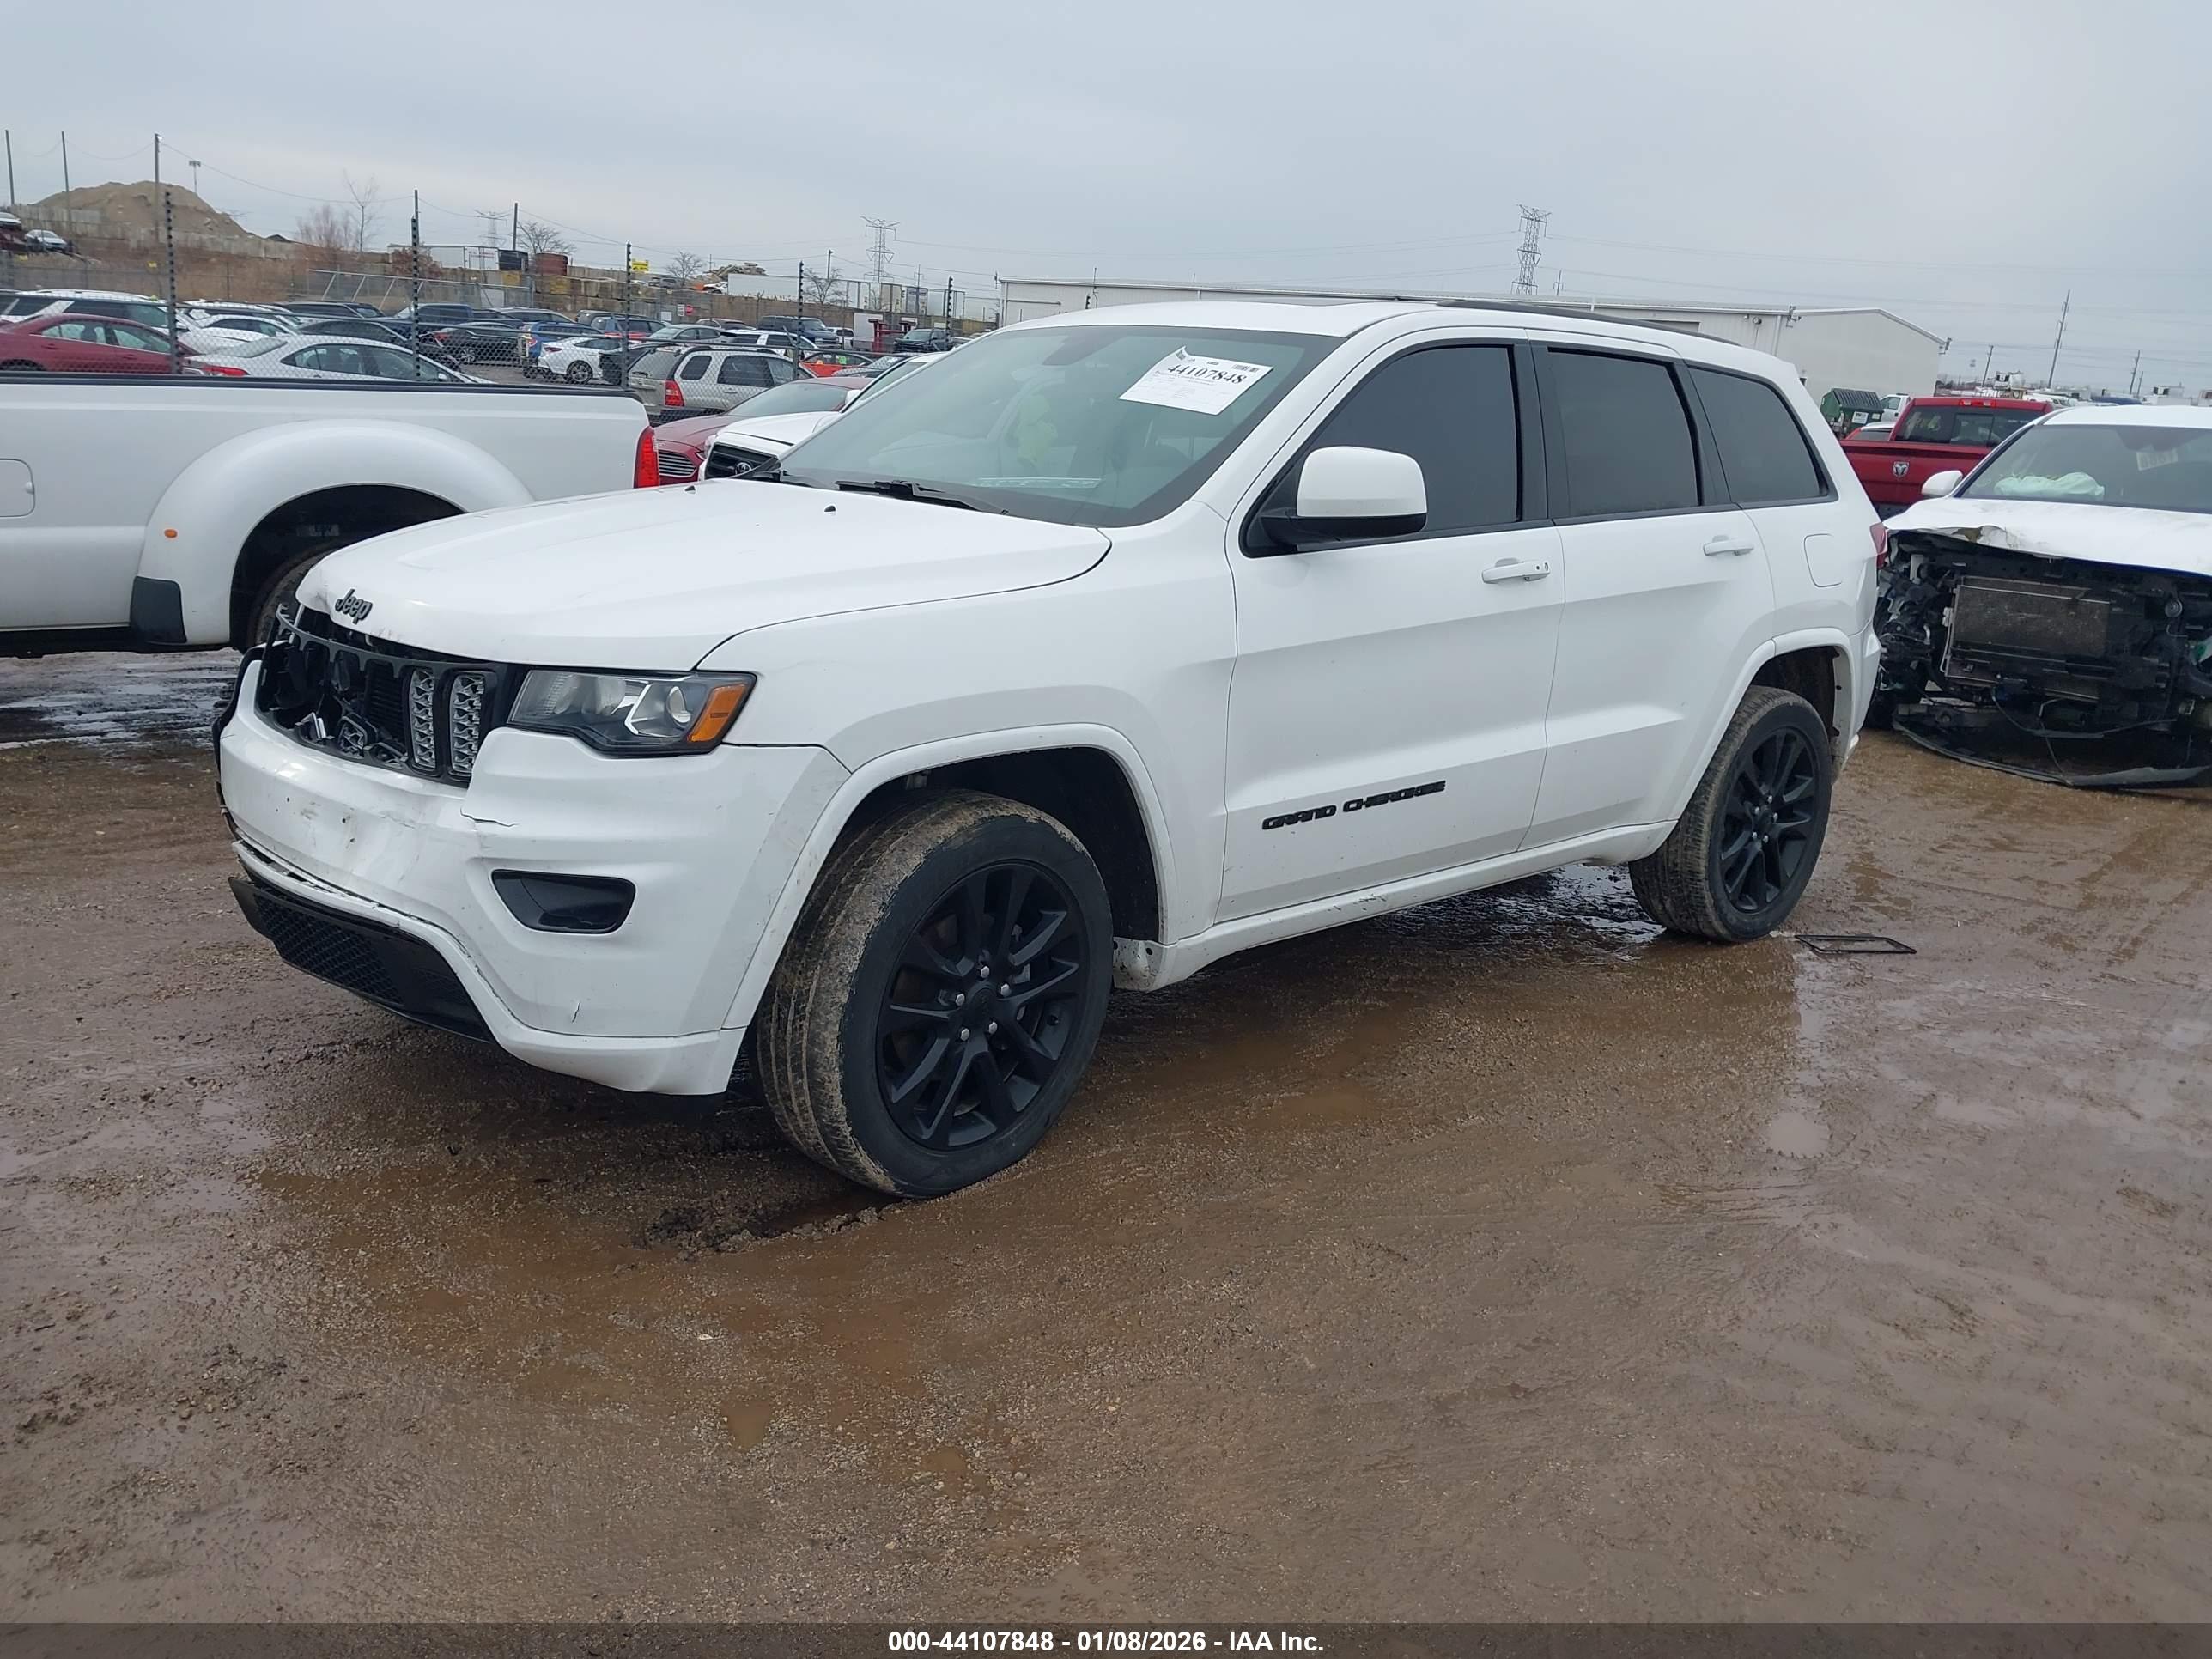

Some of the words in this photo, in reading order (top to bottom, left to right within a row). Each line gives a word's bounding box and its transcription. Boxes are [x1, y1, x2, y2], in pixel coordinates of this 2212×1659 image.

[1169, 364, 1247, 384] 44107848
[335, 588, 373, 625] Jeep
[1261, 804, 1337, 830] GRAND
[1342, 780, 1446, 812] CHEROKEE
